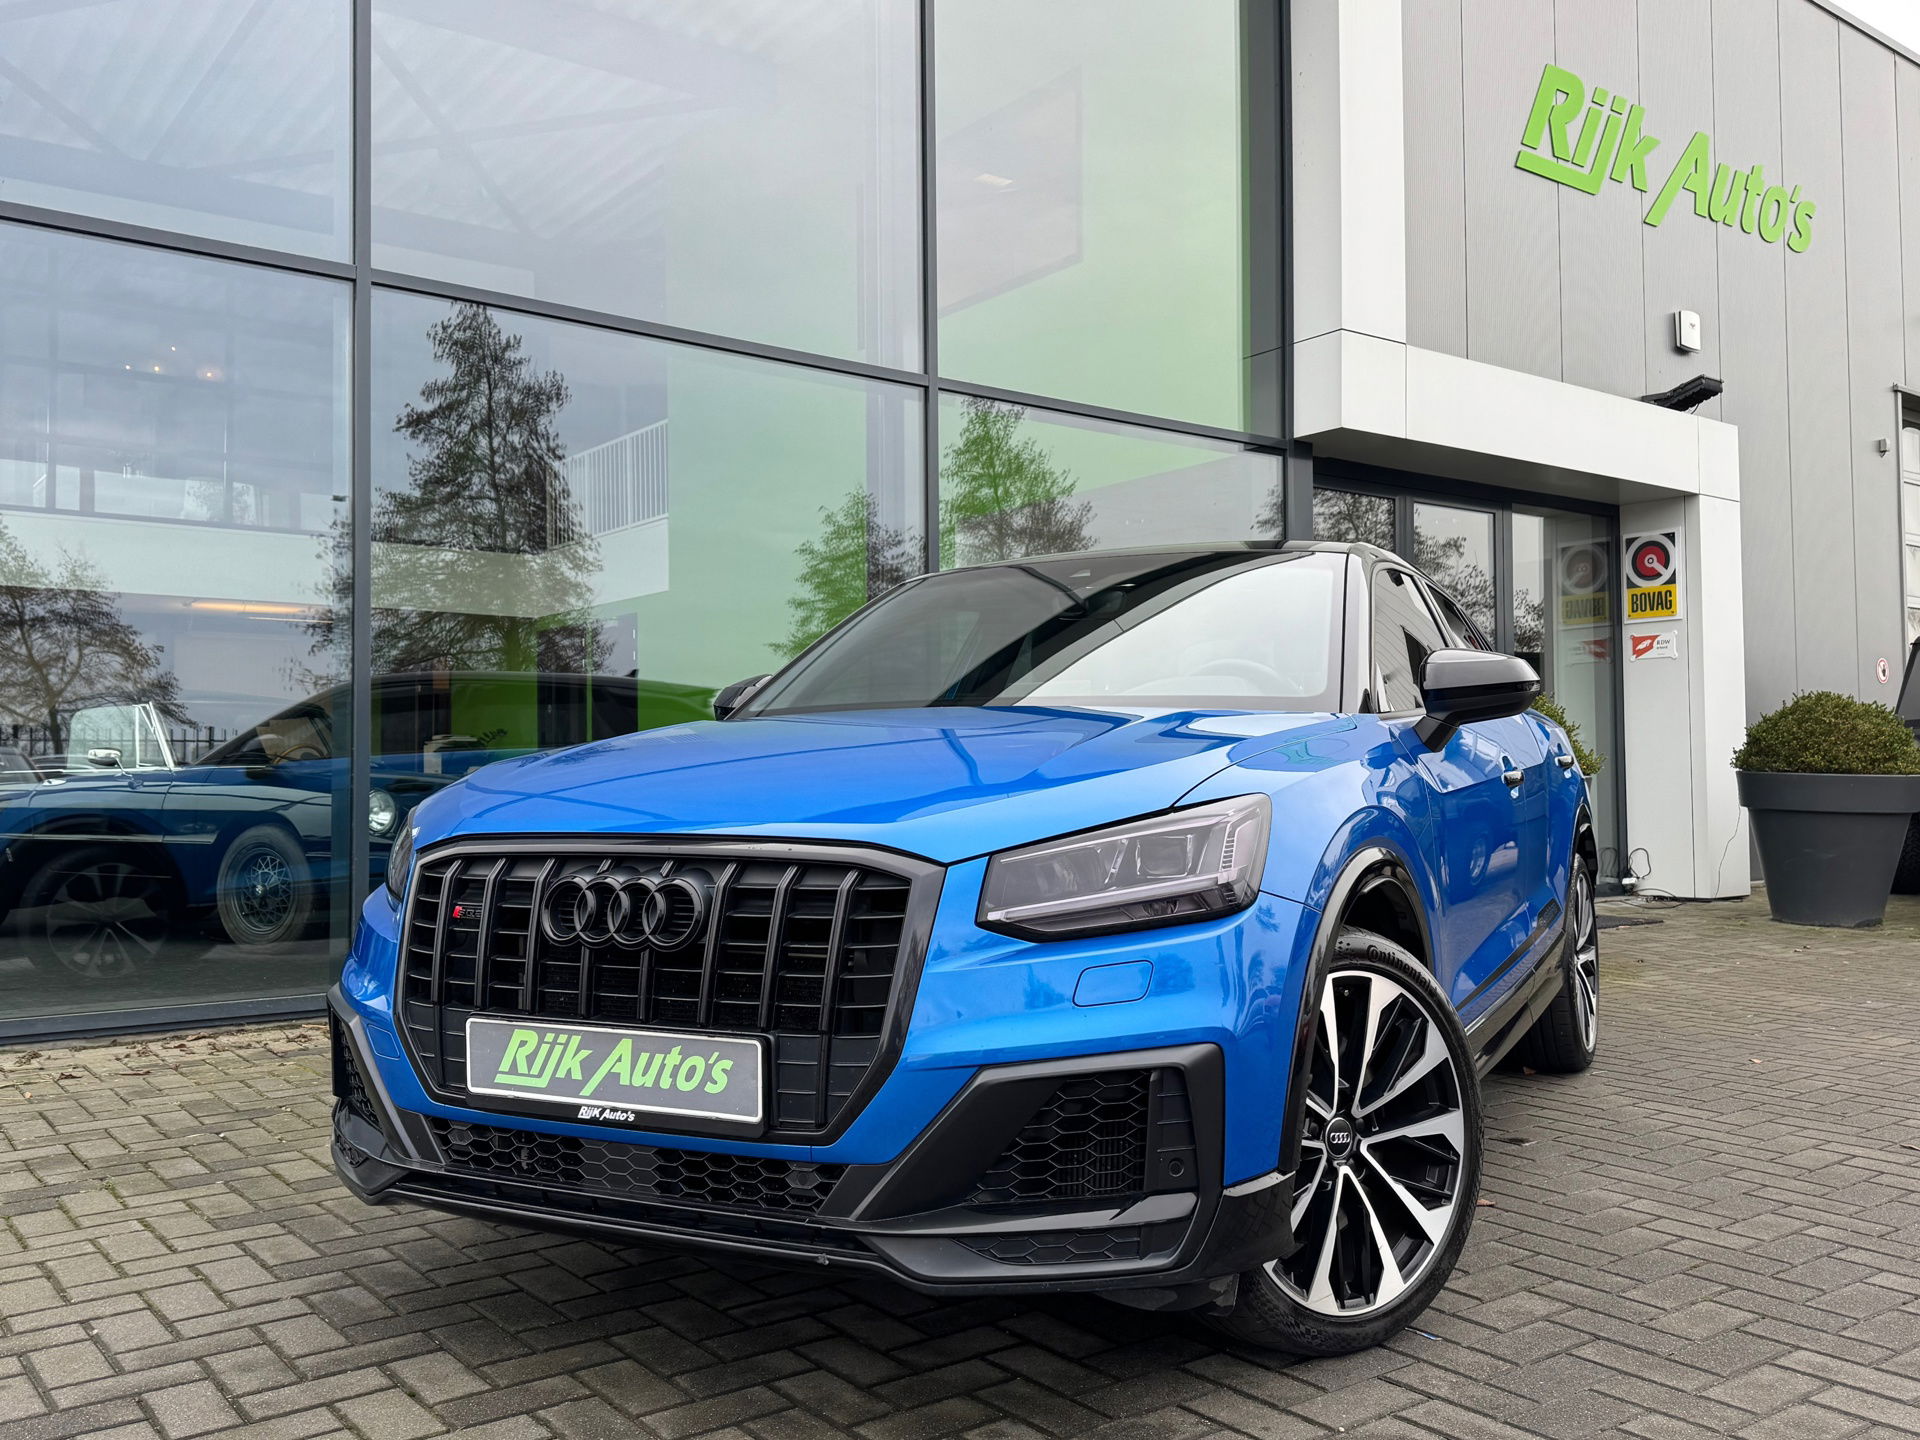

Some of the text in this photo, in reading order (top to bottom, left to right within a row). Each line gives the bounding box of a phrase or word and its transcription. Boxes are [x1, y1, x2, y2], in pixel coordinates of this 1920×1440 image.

[1514, 63, 1816, 253] Rijk Auto's
[1631, 590, 1672, 613] BOVAG
[1366, 945, 1430, 993] Continental
[494, 1028, 734, 1096] Rijk Auto's
[599, 1108, 635, 1122] Auto's
